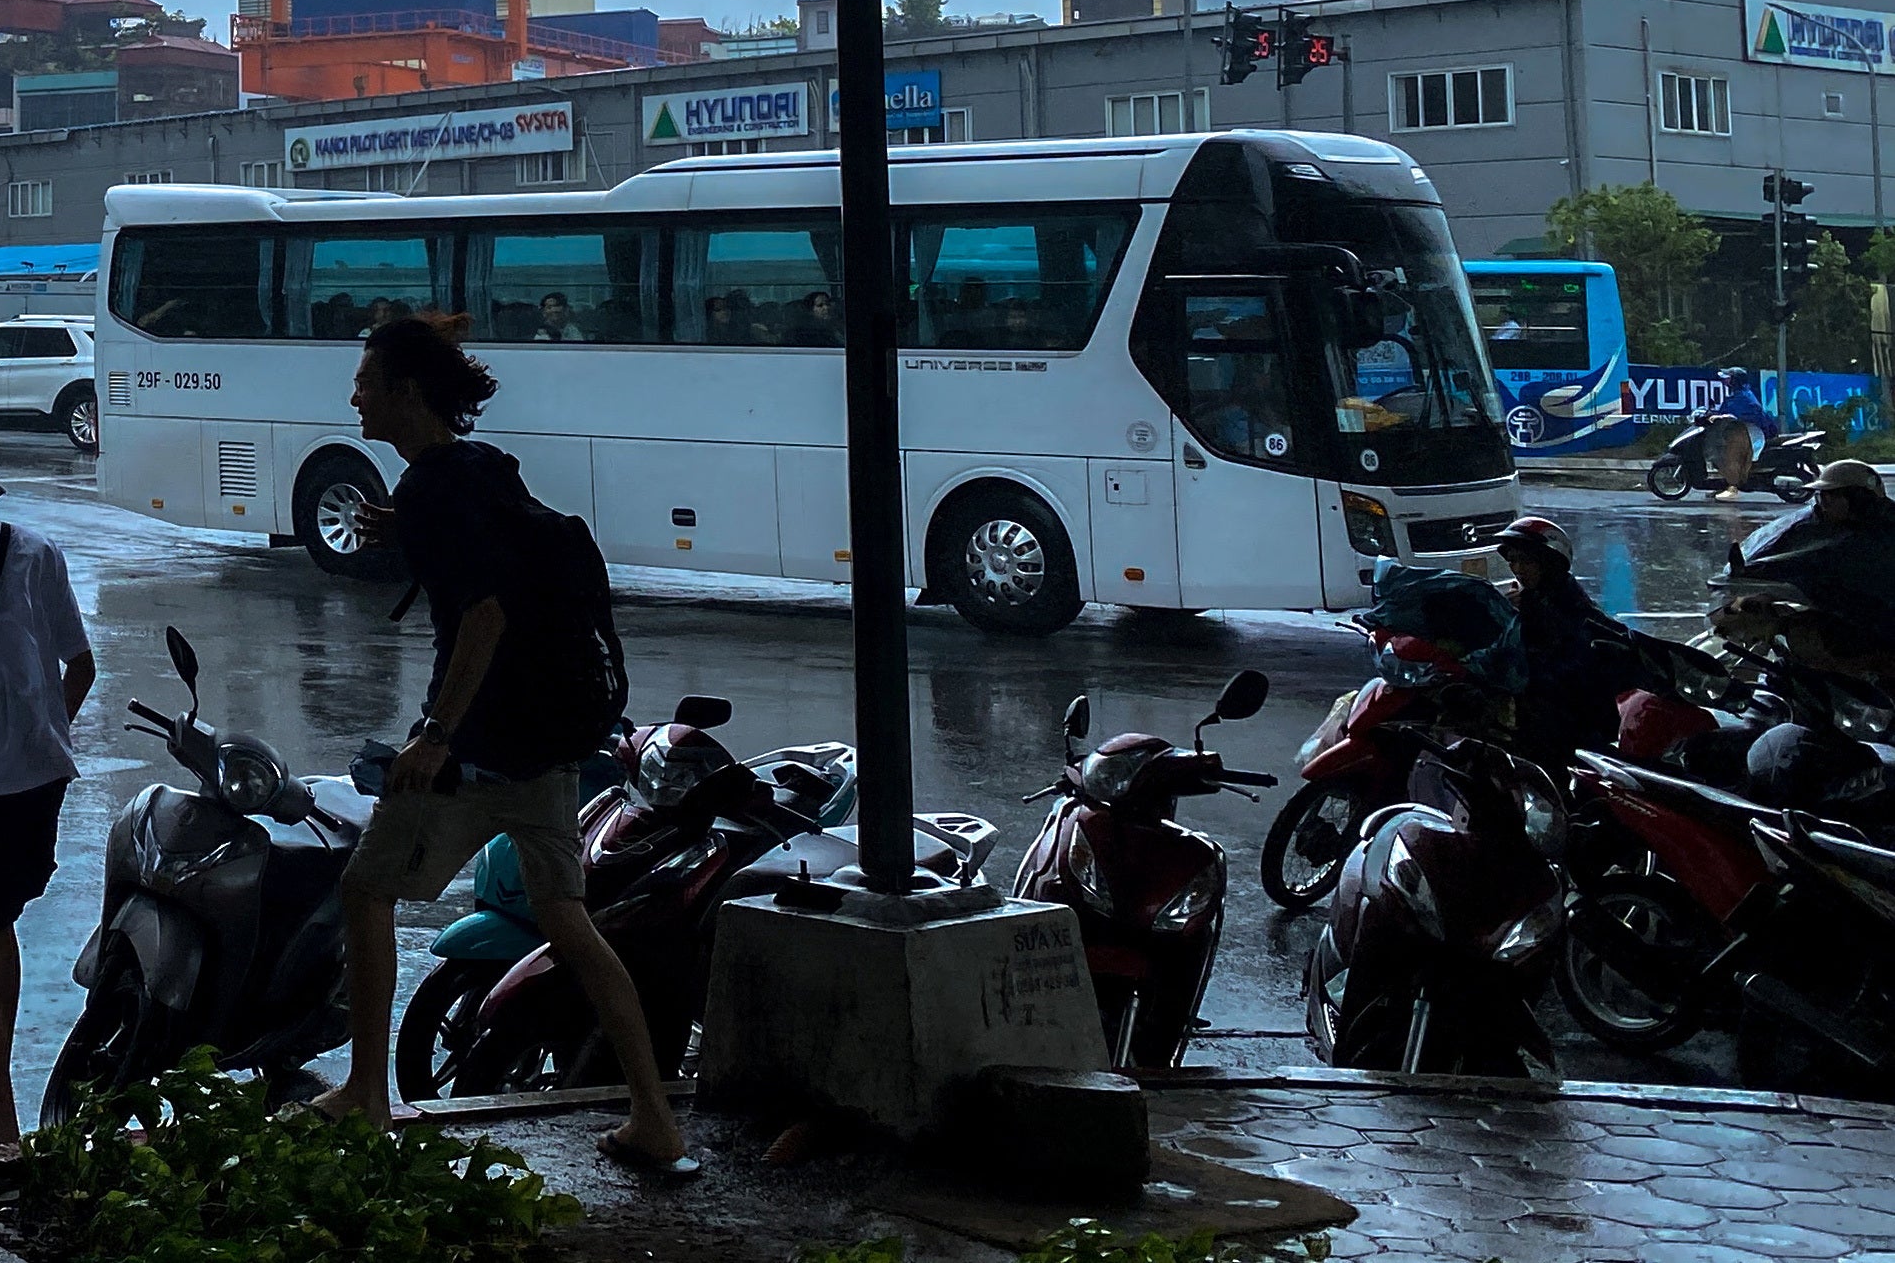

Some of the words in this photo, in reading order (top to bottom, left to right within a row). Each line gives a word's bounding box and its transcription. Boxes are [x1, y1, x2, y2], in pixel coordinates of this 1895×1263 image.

[686, 91, 799, 125] HYUNDAI
[885, 85, 932, 110] ella
[315, 136, 349, 156] HANOI
[350, 133, 378, 153] PILOT
[905, 360, 1012, 371] UNIVERSE
[137, 371, 161, 388] 29F
[174, 372, 221, 390] 029.50
[1268, 438, 1284, 450] 86
